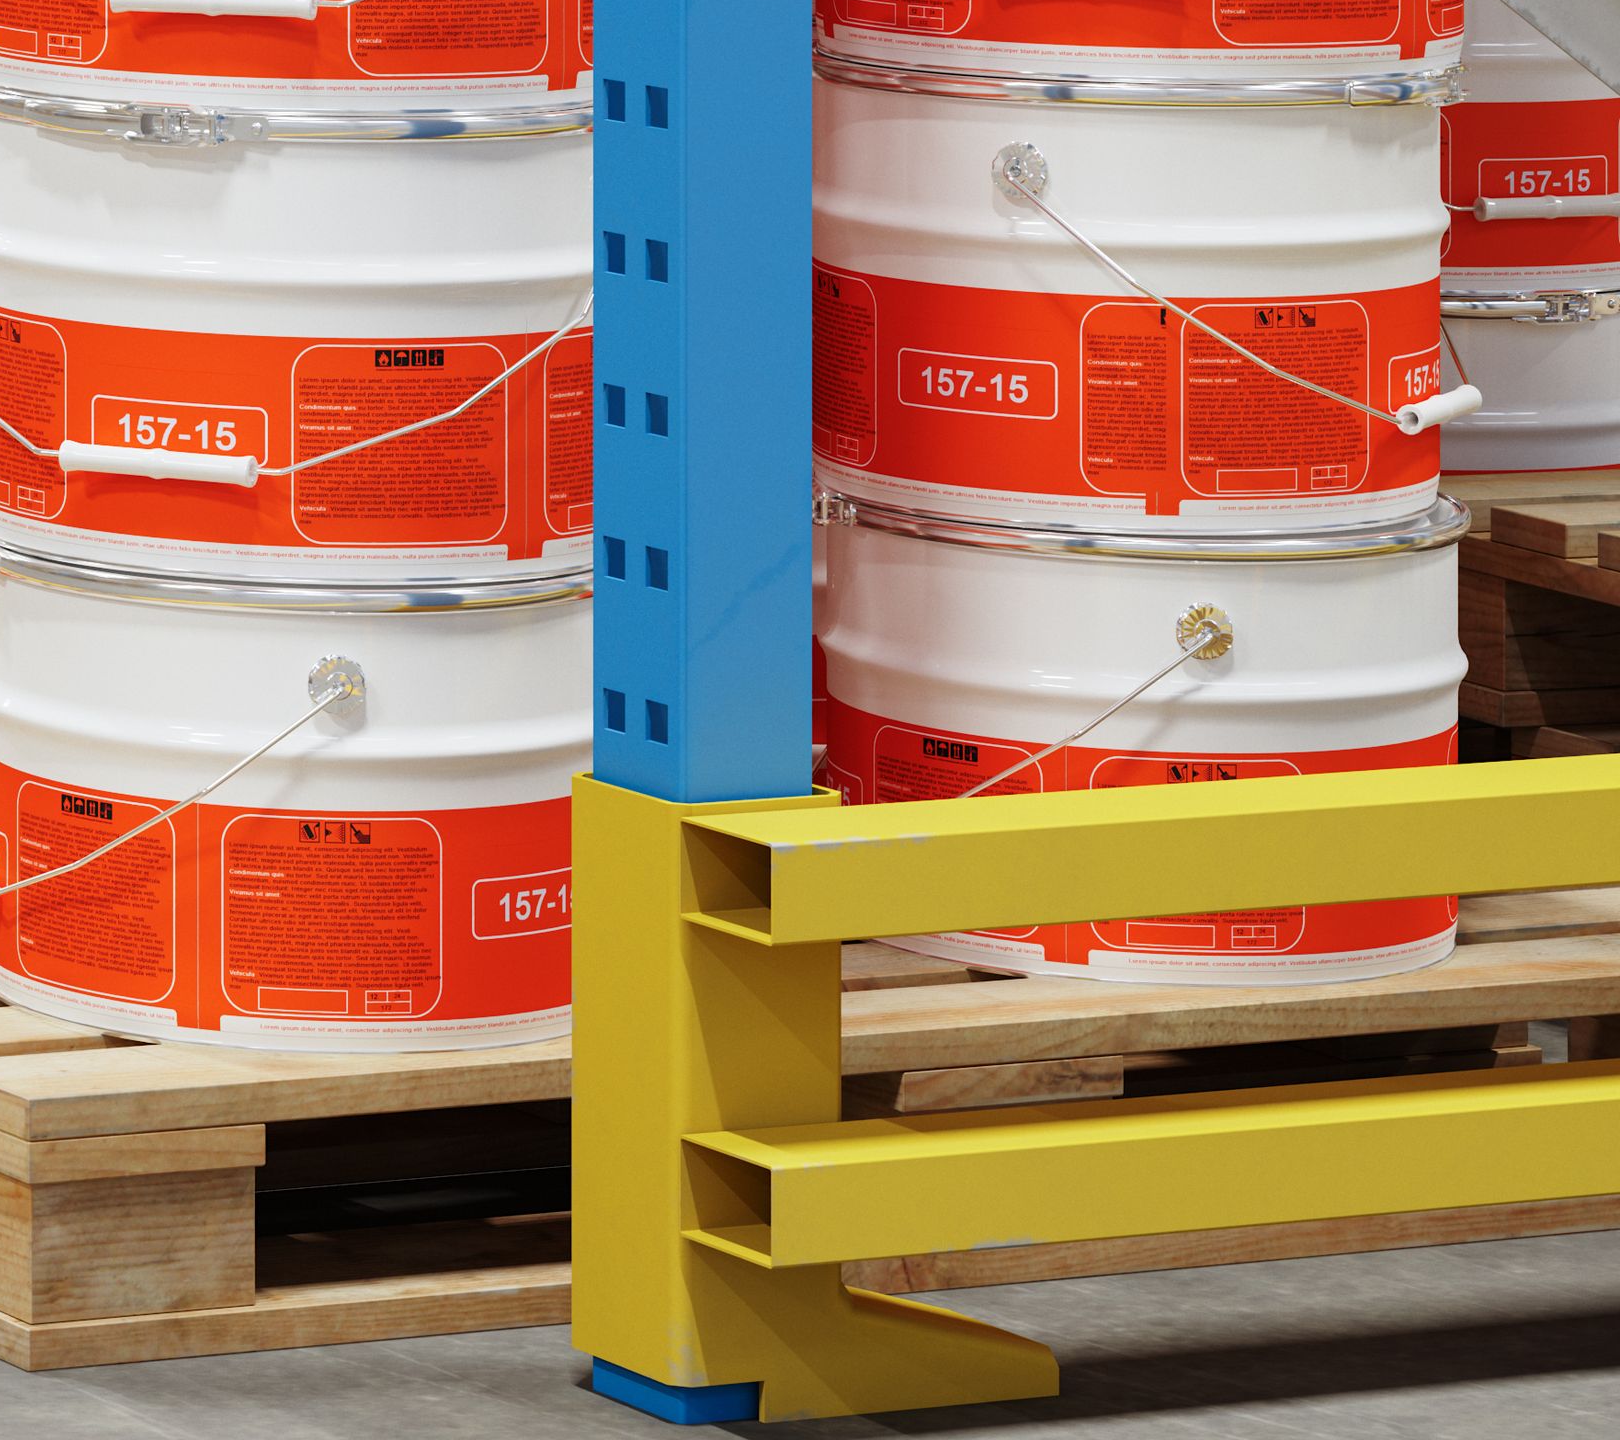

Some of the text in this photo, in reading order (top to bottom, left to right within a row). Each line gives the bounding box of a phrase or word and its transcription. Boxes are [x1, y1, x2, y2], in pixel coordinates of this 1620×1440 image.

[1505, 170, 1590, 193] 157-15
[921, 367, 1029, 404] 157-15
[118, 415, 236, 450] 157-15
[501, 883, 571, 922] 157-1
